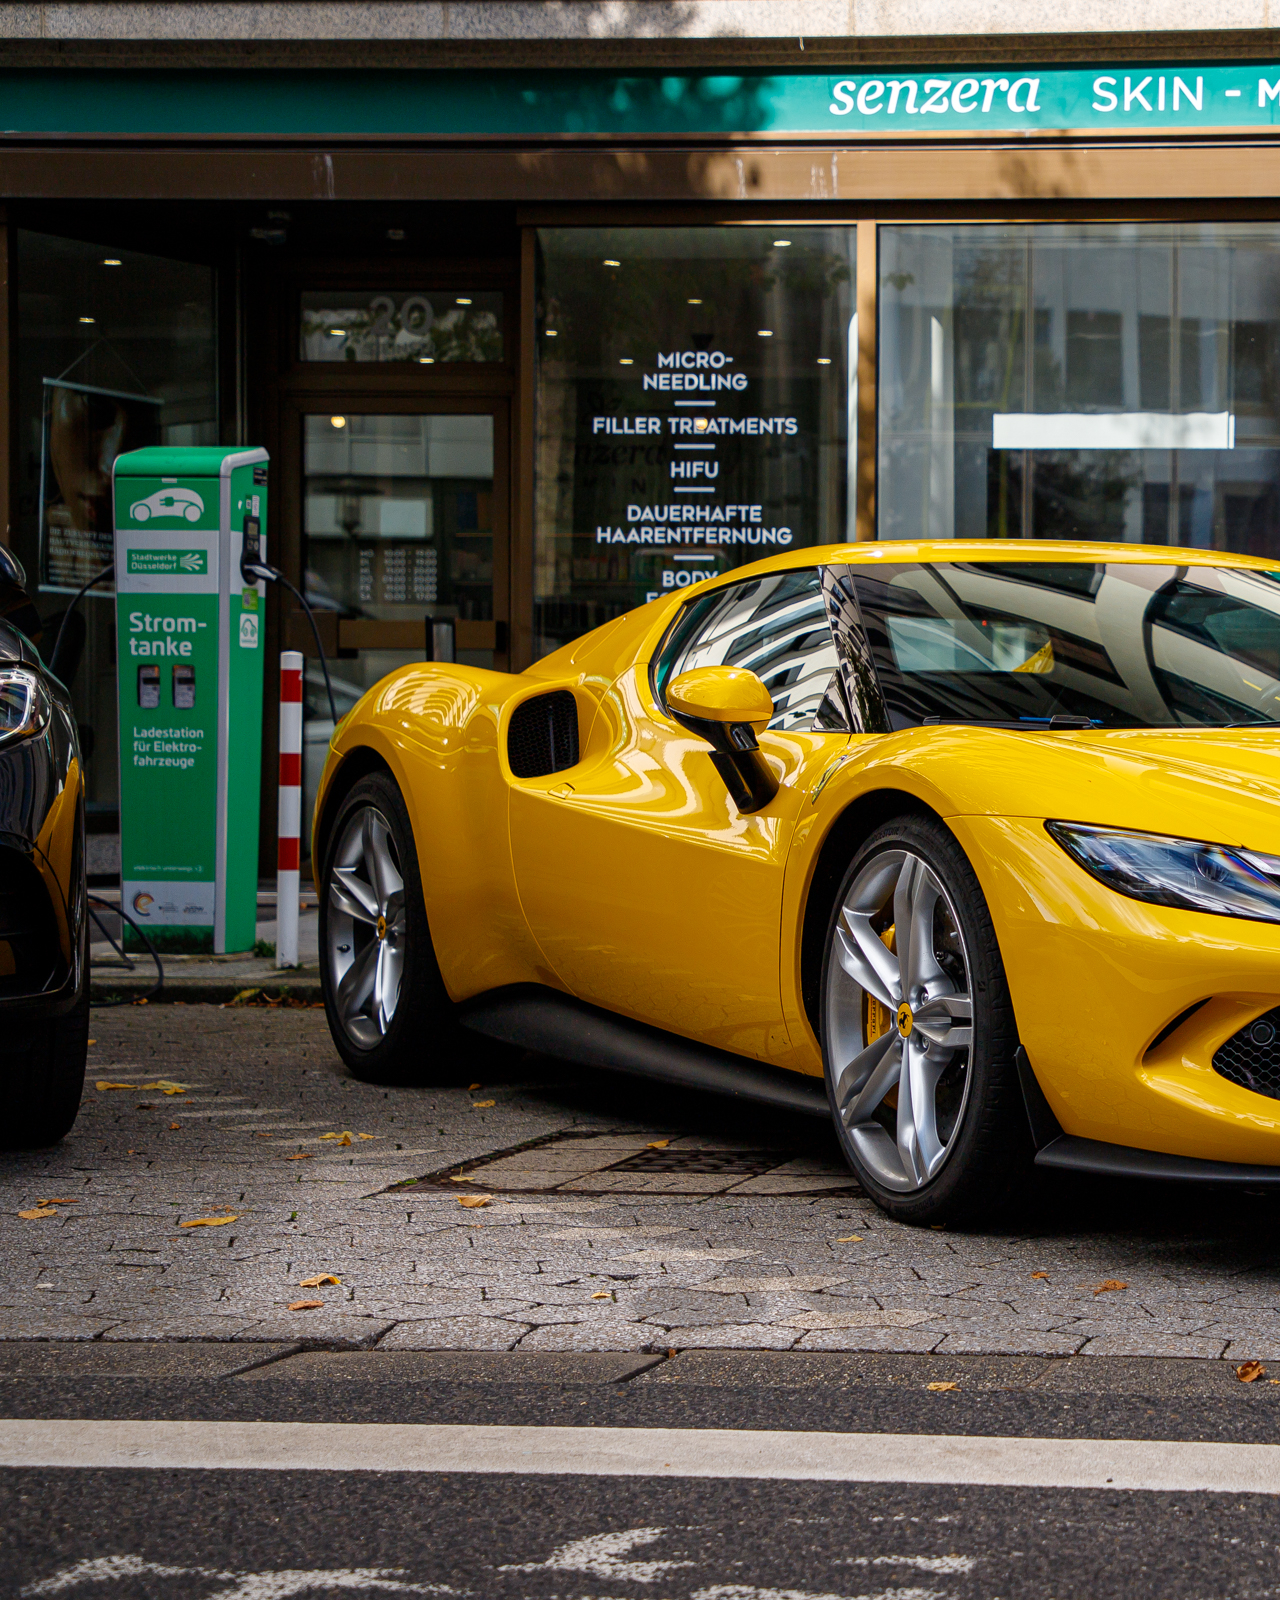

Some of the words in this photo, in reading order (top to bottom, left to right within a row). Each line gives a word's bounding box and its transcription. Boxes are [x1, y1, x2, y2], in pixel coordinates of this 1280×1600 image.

[829, 77, 1041, 116] senzera
[1092, 76, 1203, 113] SKIN
[657, 351, 734, 369] MICRO-
[643, 373, 749, 391] NEEDLING
[593, 416, 662, 435] FILLER
[667, 416, 799, 436] TREATMENTS
[670, 461, 719, 479] HIFU
[626, 504, 763, 523] DAUERHAFTE
[596, 526, 794, 545] HAARENTFERNUNG
[131, 553, 177, 561] Stadtwerke
[131, 561, 177, 570] Düsseldorf
[129, 612, 208, 633] Strom-
[129, 636, 193, 656] tanke
[133, 726, 204, 739] Ladestation
[133, 741, 152, 753] für
[153, 741, 203, 753] Elektro-
[133, 755, 195, 769] fahrzeuge
